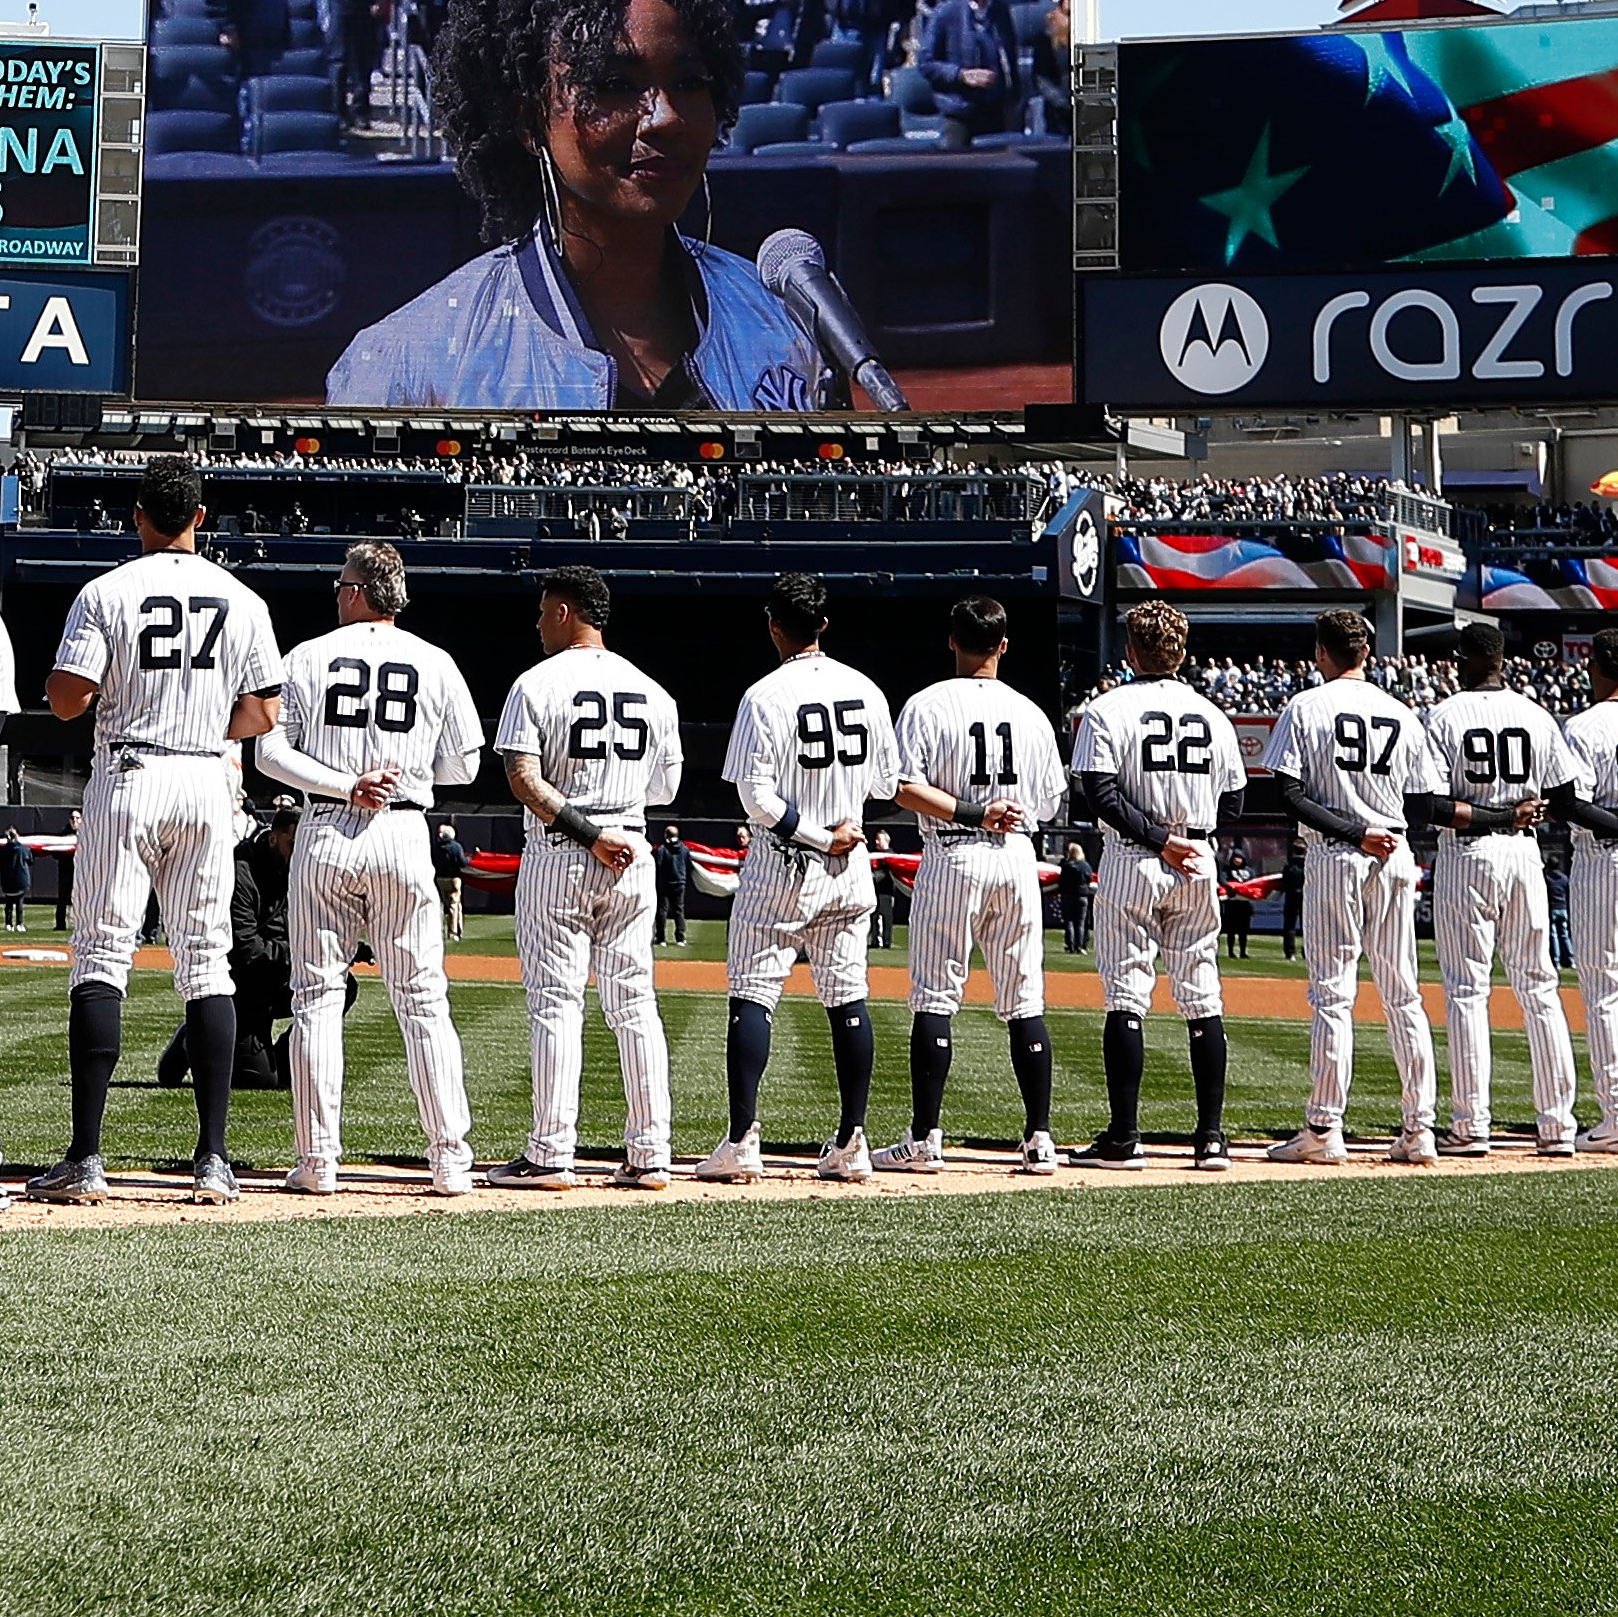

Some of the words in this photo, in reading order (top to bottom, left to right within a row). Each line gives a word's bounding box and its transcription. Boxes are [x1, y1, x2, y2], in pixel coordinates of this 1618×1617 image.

[1313, 282, 1613, 385] razr
[516, 444, 569, 455] Mastercard
[571, 446, 605, 455] Batter's
[138, 595, 230, 671] 27
[324, 657, 421, 733] 28
[570, 690, 648, 761] 25
[797, 700, 868, 769] 95
[968, 722, 1019, 785] 11
[1140, 710, 1212, 775] 22
[1334, 713, 1402, 775] 97
[1463, 728, 1531, 784] 90
